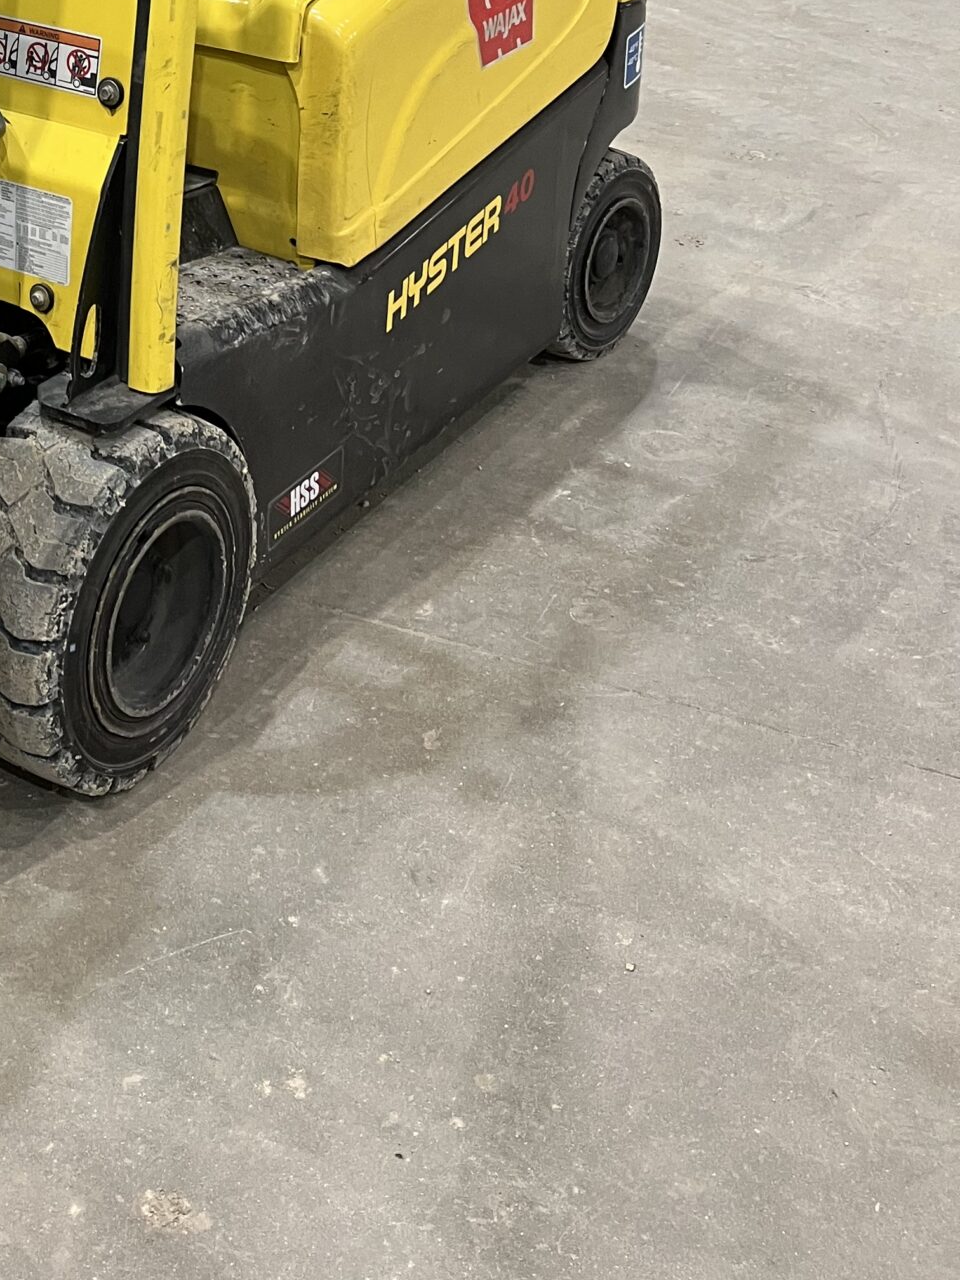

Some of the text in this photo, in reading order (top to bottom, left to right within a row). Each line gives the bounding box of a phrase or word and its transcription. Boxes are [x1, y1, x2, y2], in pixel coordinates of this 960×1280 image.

[28, 27, 60, 41] WARNING
[482, 0, 528, 42] WAJAX
[385, 168, 536, 333] HYSTER 40
[290, 471, 320, 518] HSS
